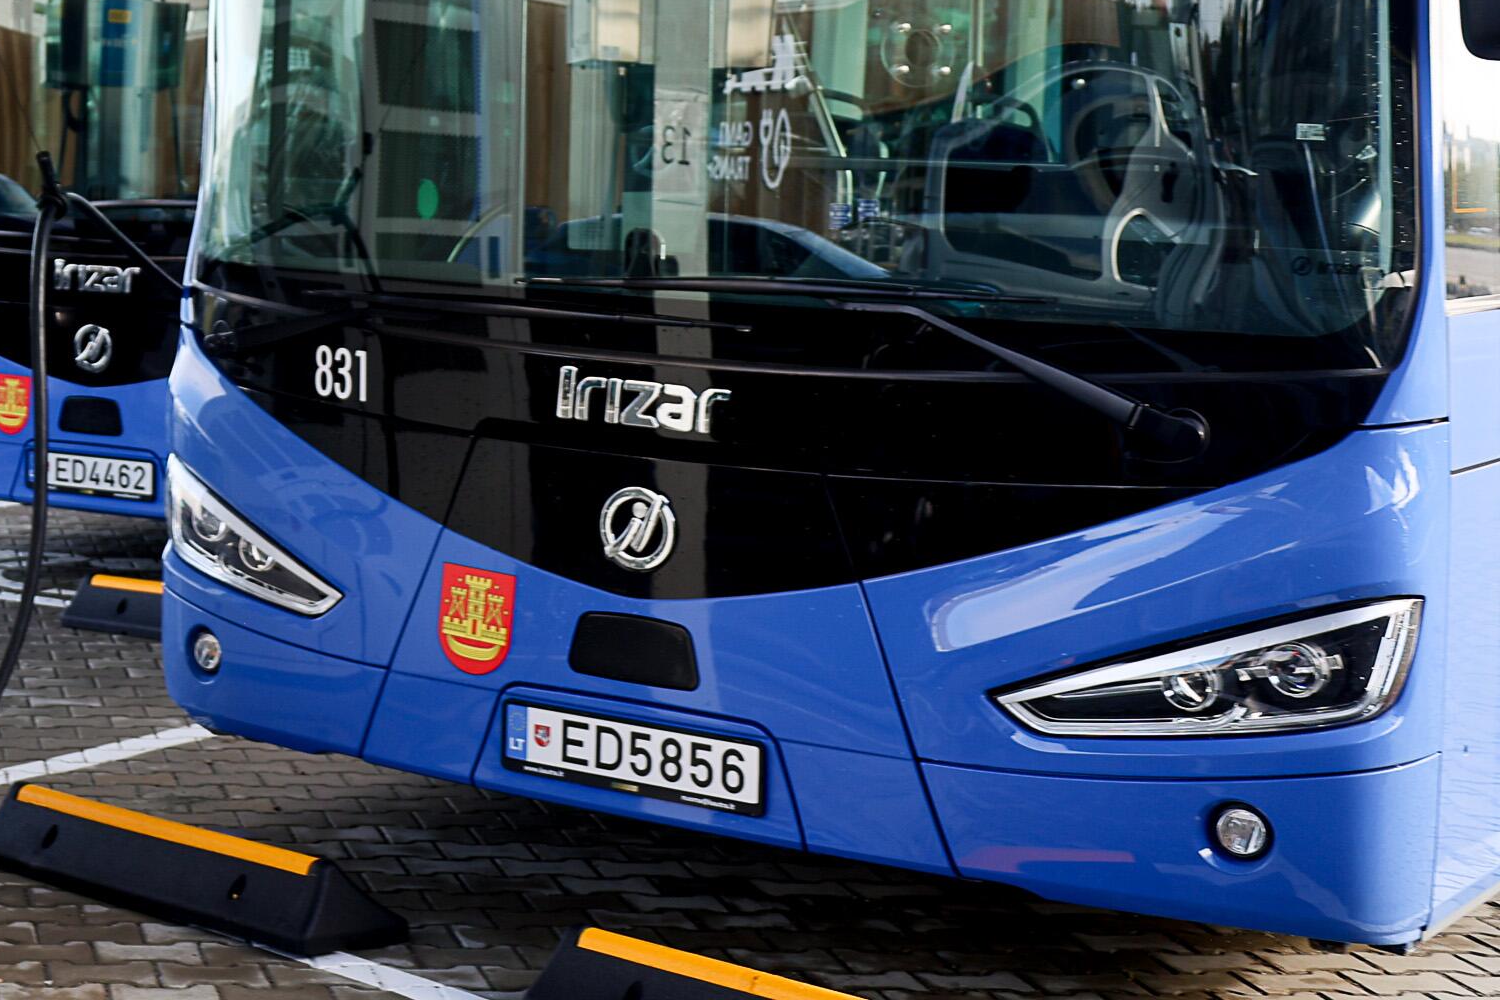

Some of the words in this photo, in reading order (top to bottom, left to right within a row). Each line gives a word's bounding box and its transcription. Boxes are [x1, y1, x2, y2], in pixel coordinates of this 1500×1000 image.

[314, 345, 367, 402] 831
[55, 457, 146, 490] ED4462
[509, 737, 525, 751] LT
[561, 718, 746, 794] ED5856
